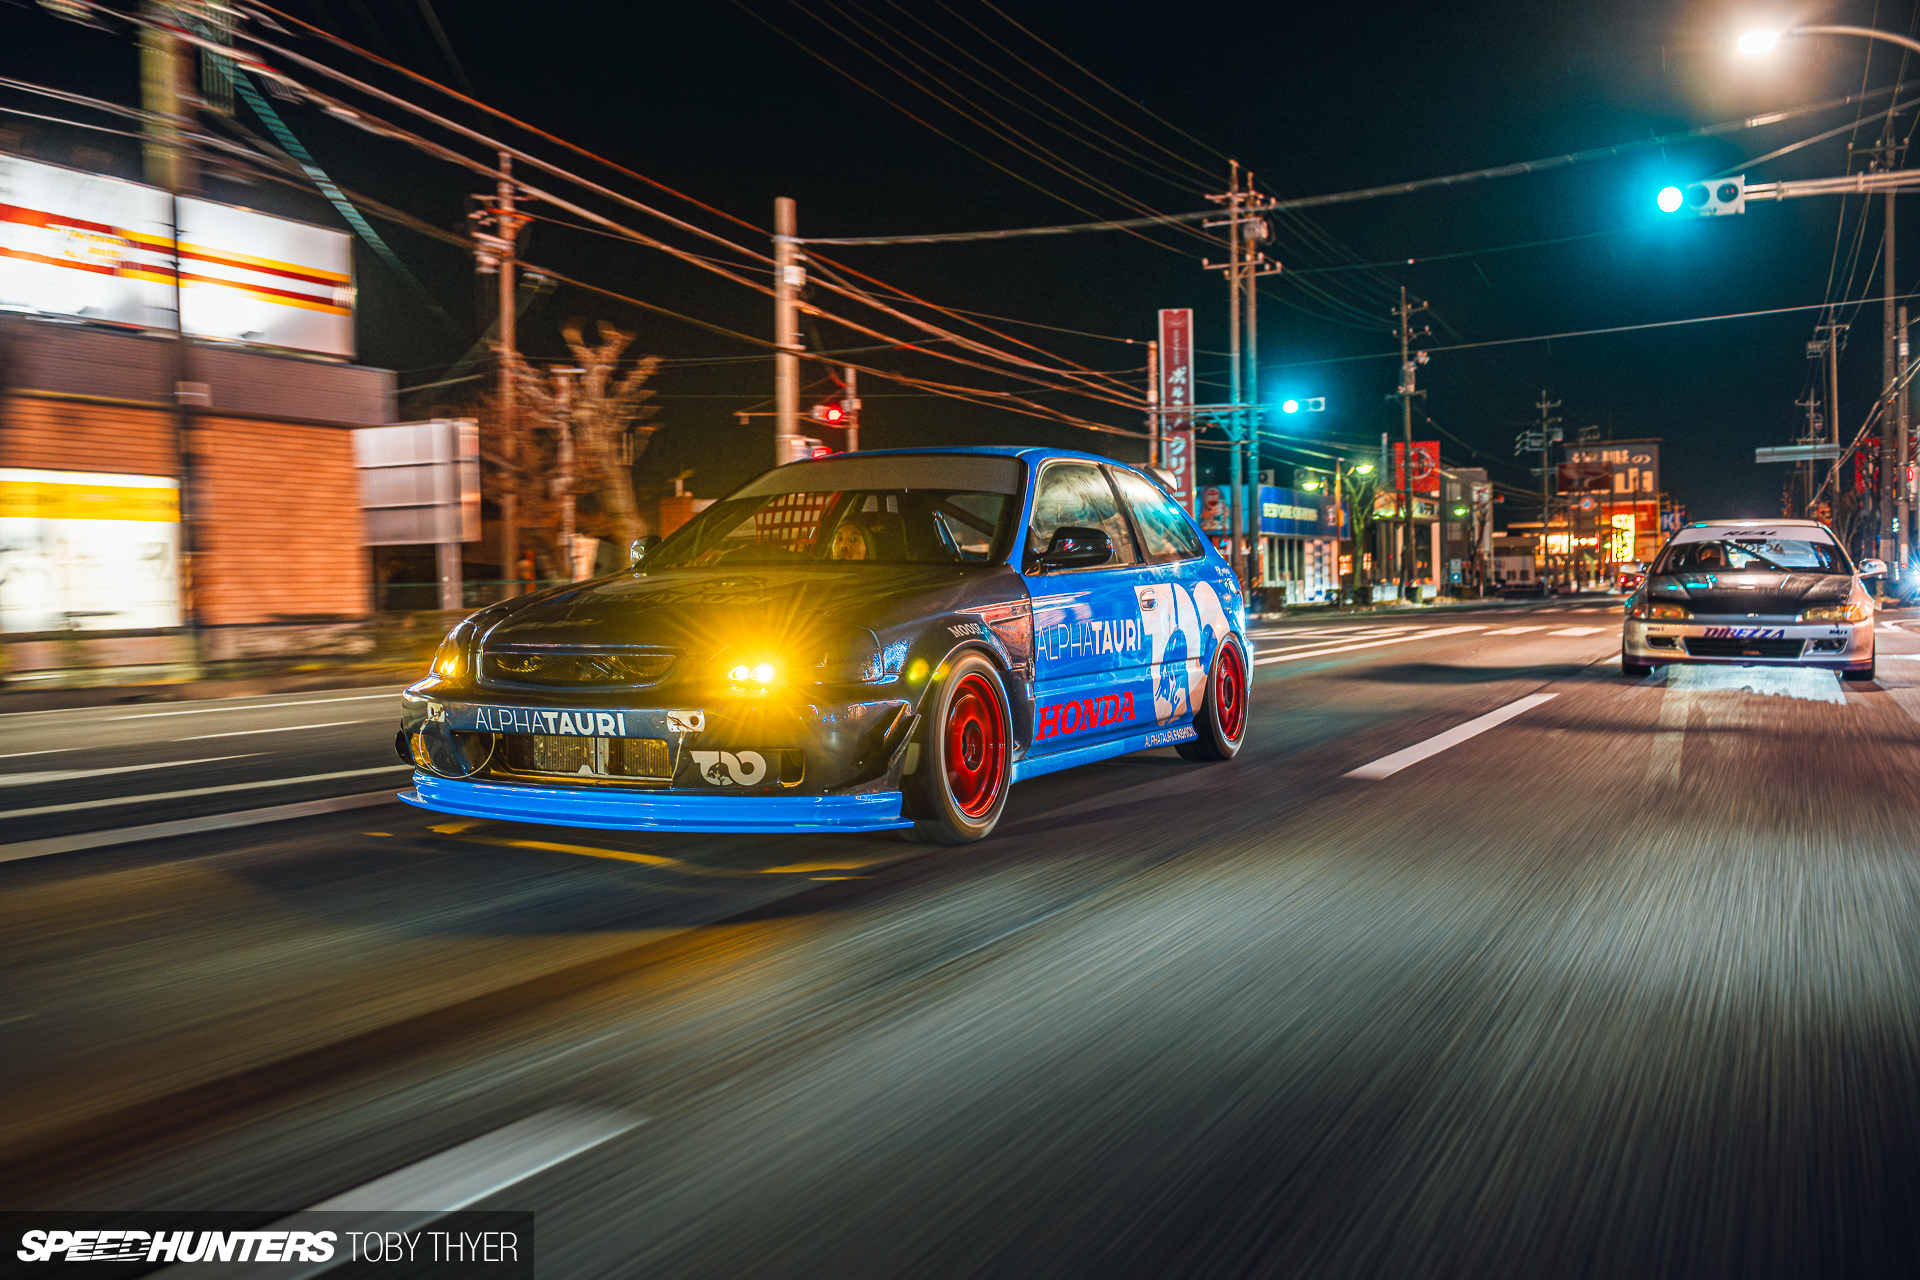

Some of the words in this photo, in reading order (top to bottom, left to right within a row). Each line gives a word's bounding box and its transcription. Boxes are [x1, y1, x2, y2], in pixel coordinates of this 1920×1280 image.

[1036, 619, 1141, 661] ALPHATAURI
[1702, 626, 1785, 639] DIREZZA
[475, 707, 627, 737] ALPHATAURI
[1034, 691, 1137, 741] HONDA
